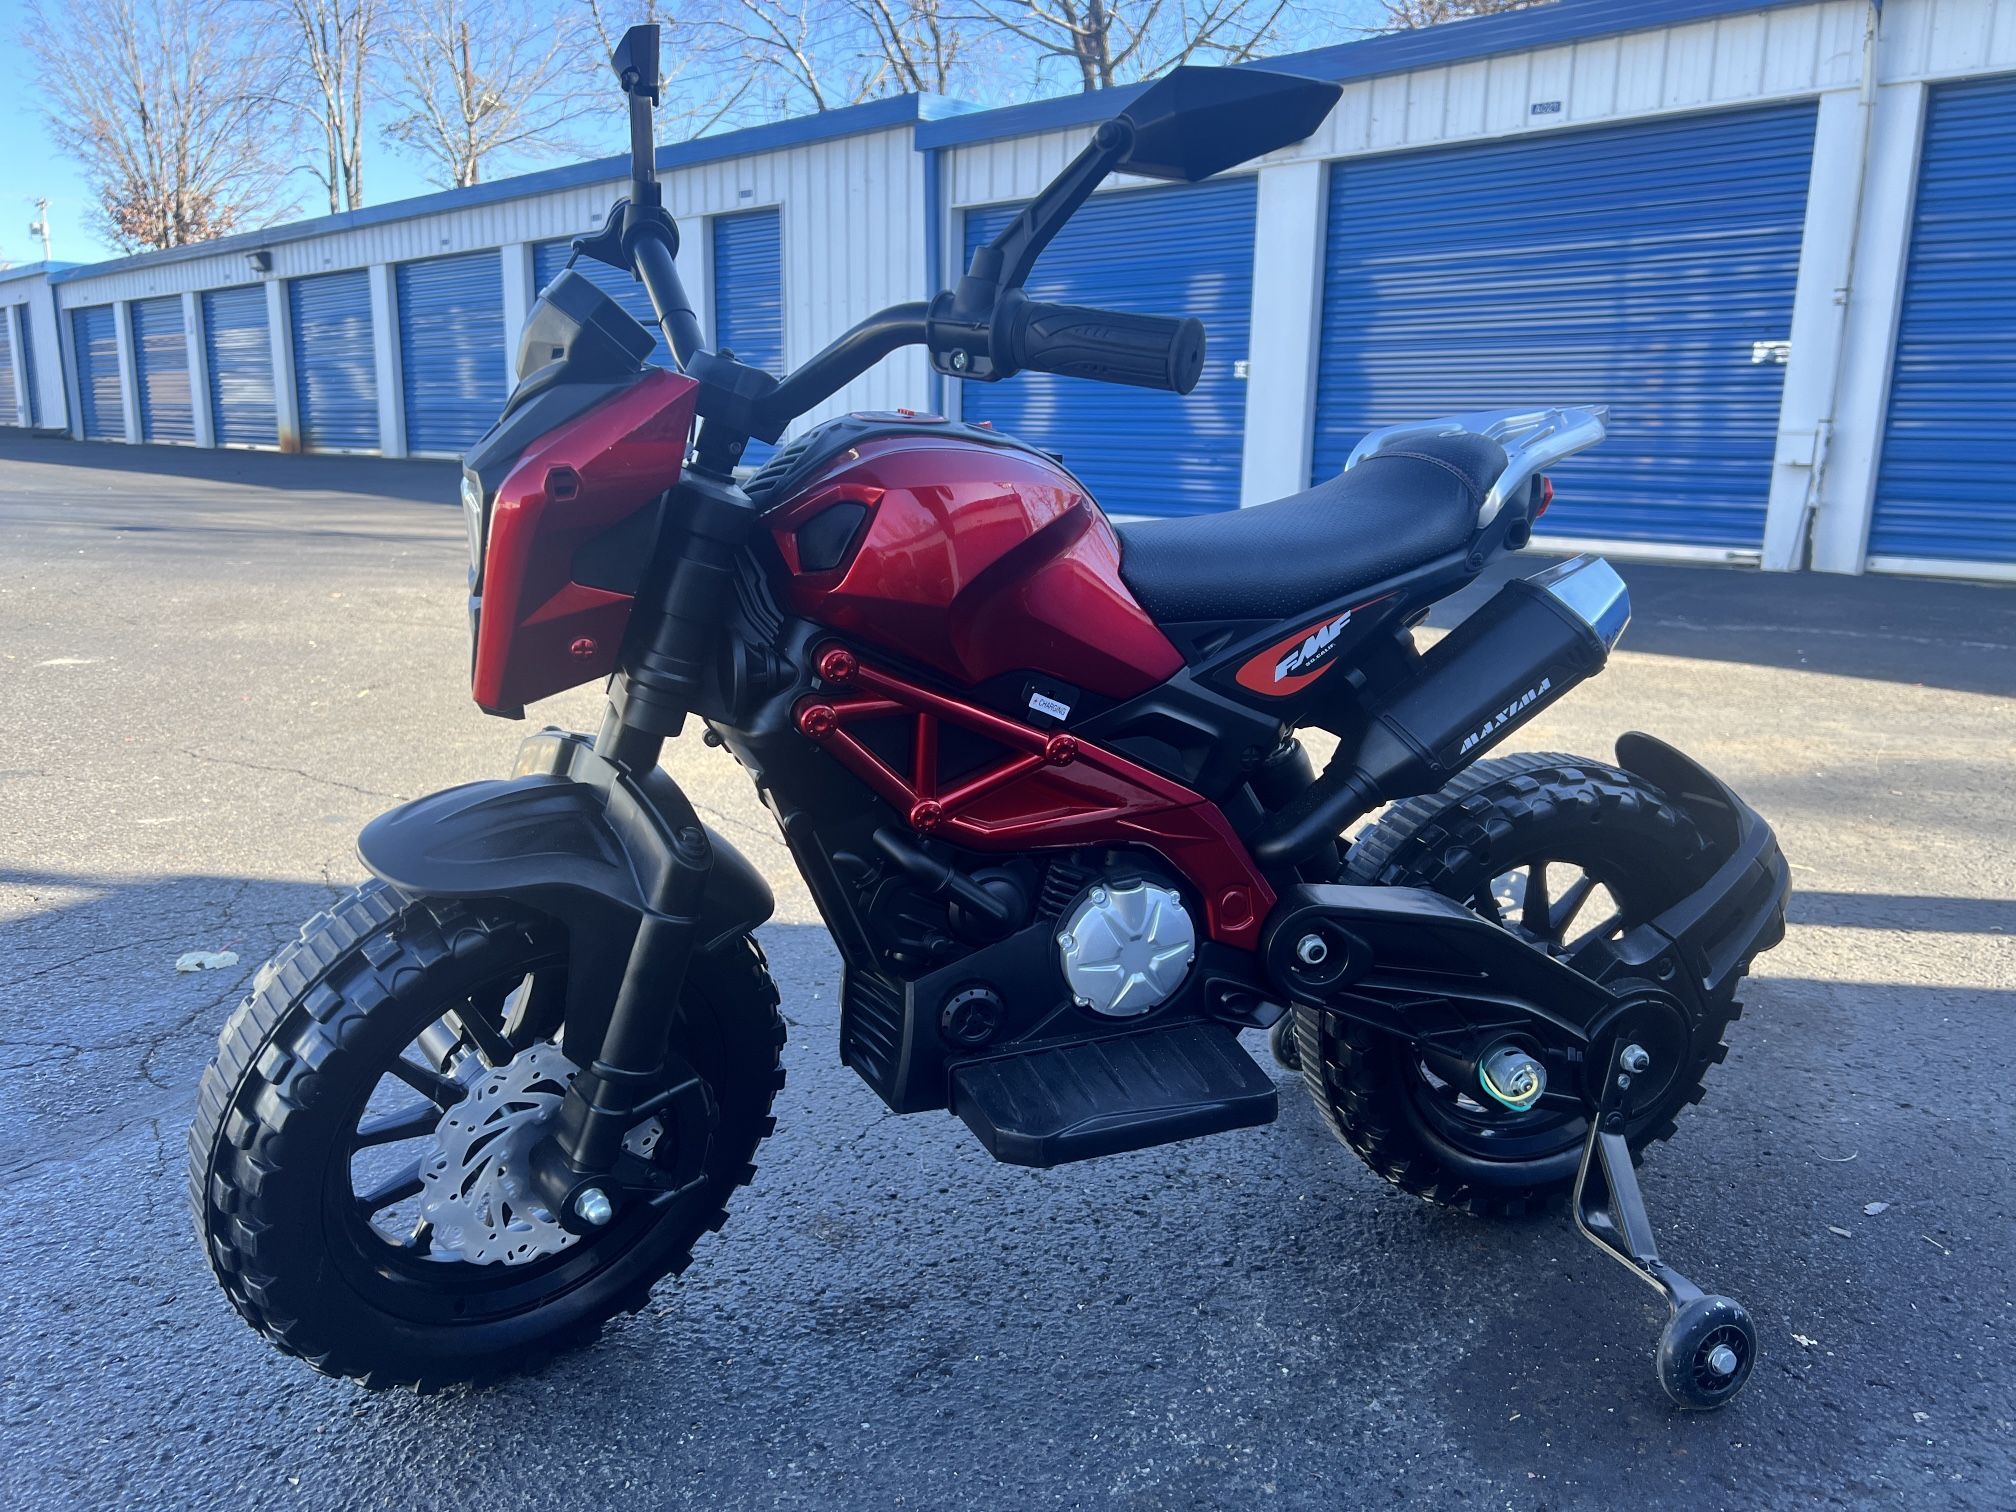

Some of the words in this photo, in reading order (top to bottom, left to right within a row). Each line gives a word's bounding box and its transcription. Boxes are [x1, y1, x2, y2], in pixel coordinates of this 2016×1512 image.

[1274, 610, 1352, 683] FMF
[1038, 698, 1067, 716] CHARGING
[1460, 677, 1551, 755] MAXIMA
